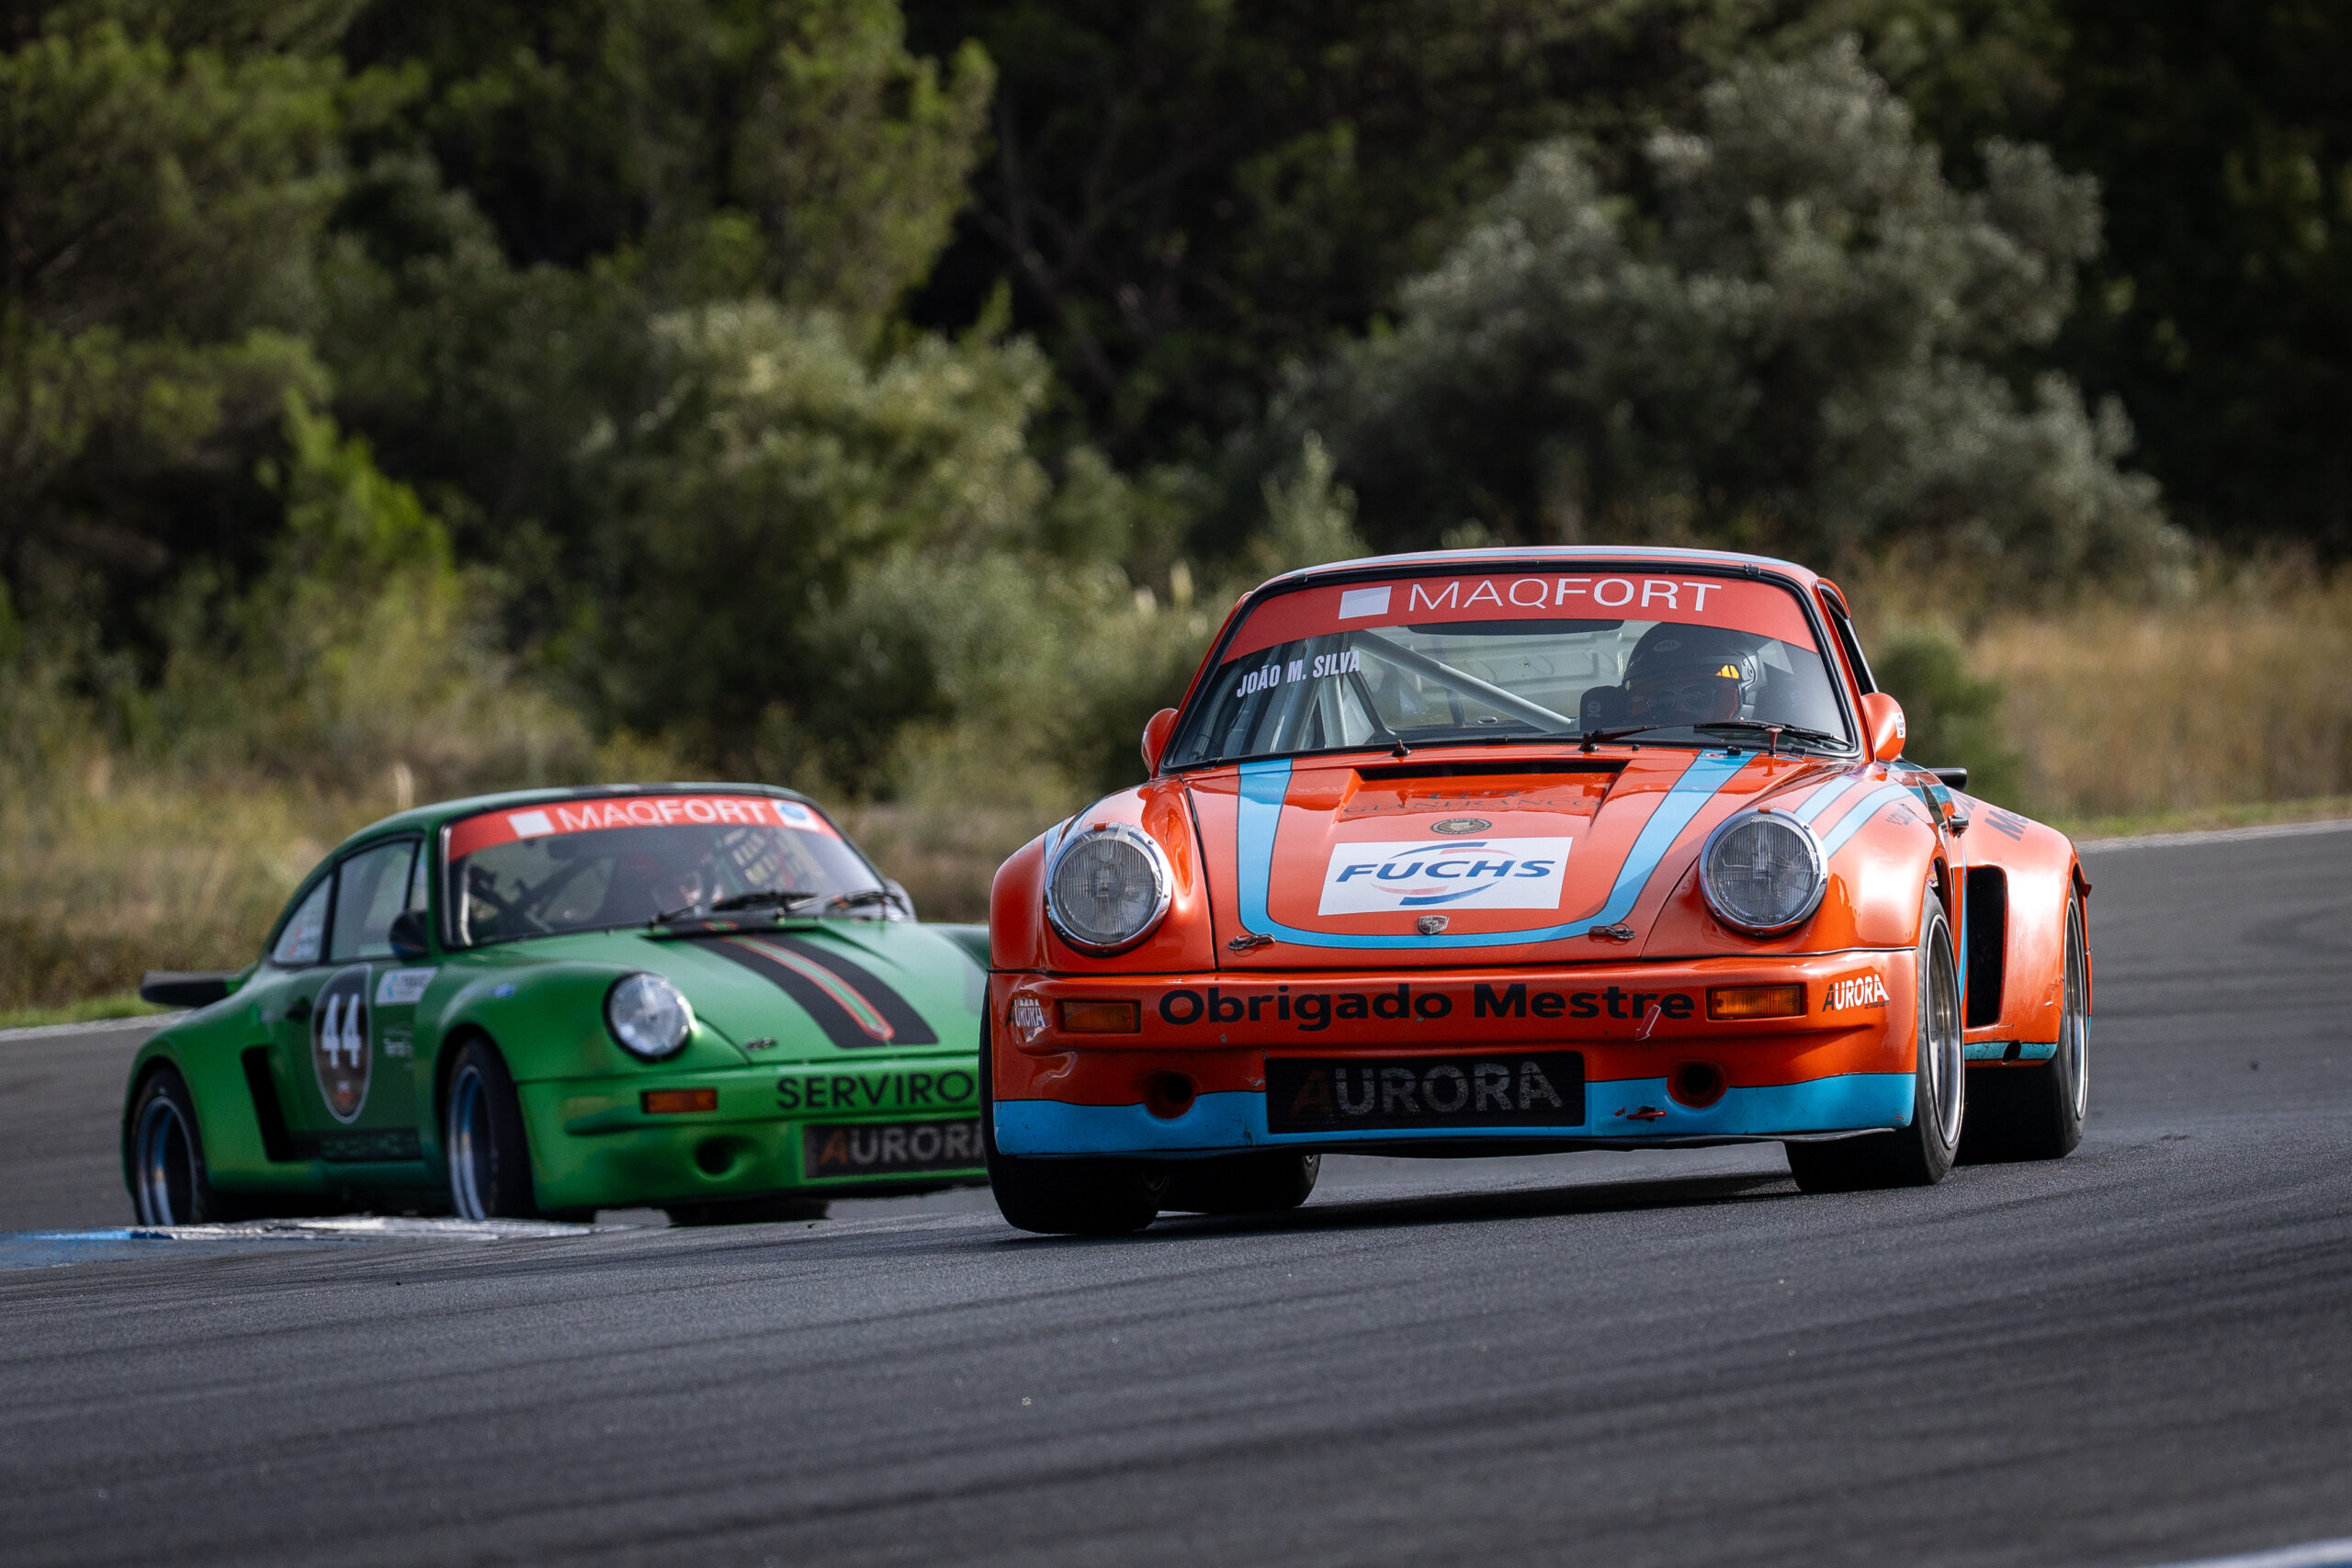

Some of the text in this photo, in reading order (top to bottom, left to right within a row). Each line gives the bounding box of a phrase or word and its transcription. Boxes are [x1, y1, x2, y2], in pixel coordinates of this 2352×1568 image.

[1408, 578, 1722, 612] MAQFORT
[1237, 649, 1361, 698] JOÃO M. SILVA
[556, 798, 768, 832] MAQFORT
[1335, 860, 1555, 883] FUCHS
[1159, 983, 1694, 1032] Obrigado Mestre
[1822, 974, 1890, 1012] AURORA
[322, 992, 362, 1069] 44
[776, 1070, 974, 1110] SERVIRO
[1292, 1060, 1563, 1116] AURORA
